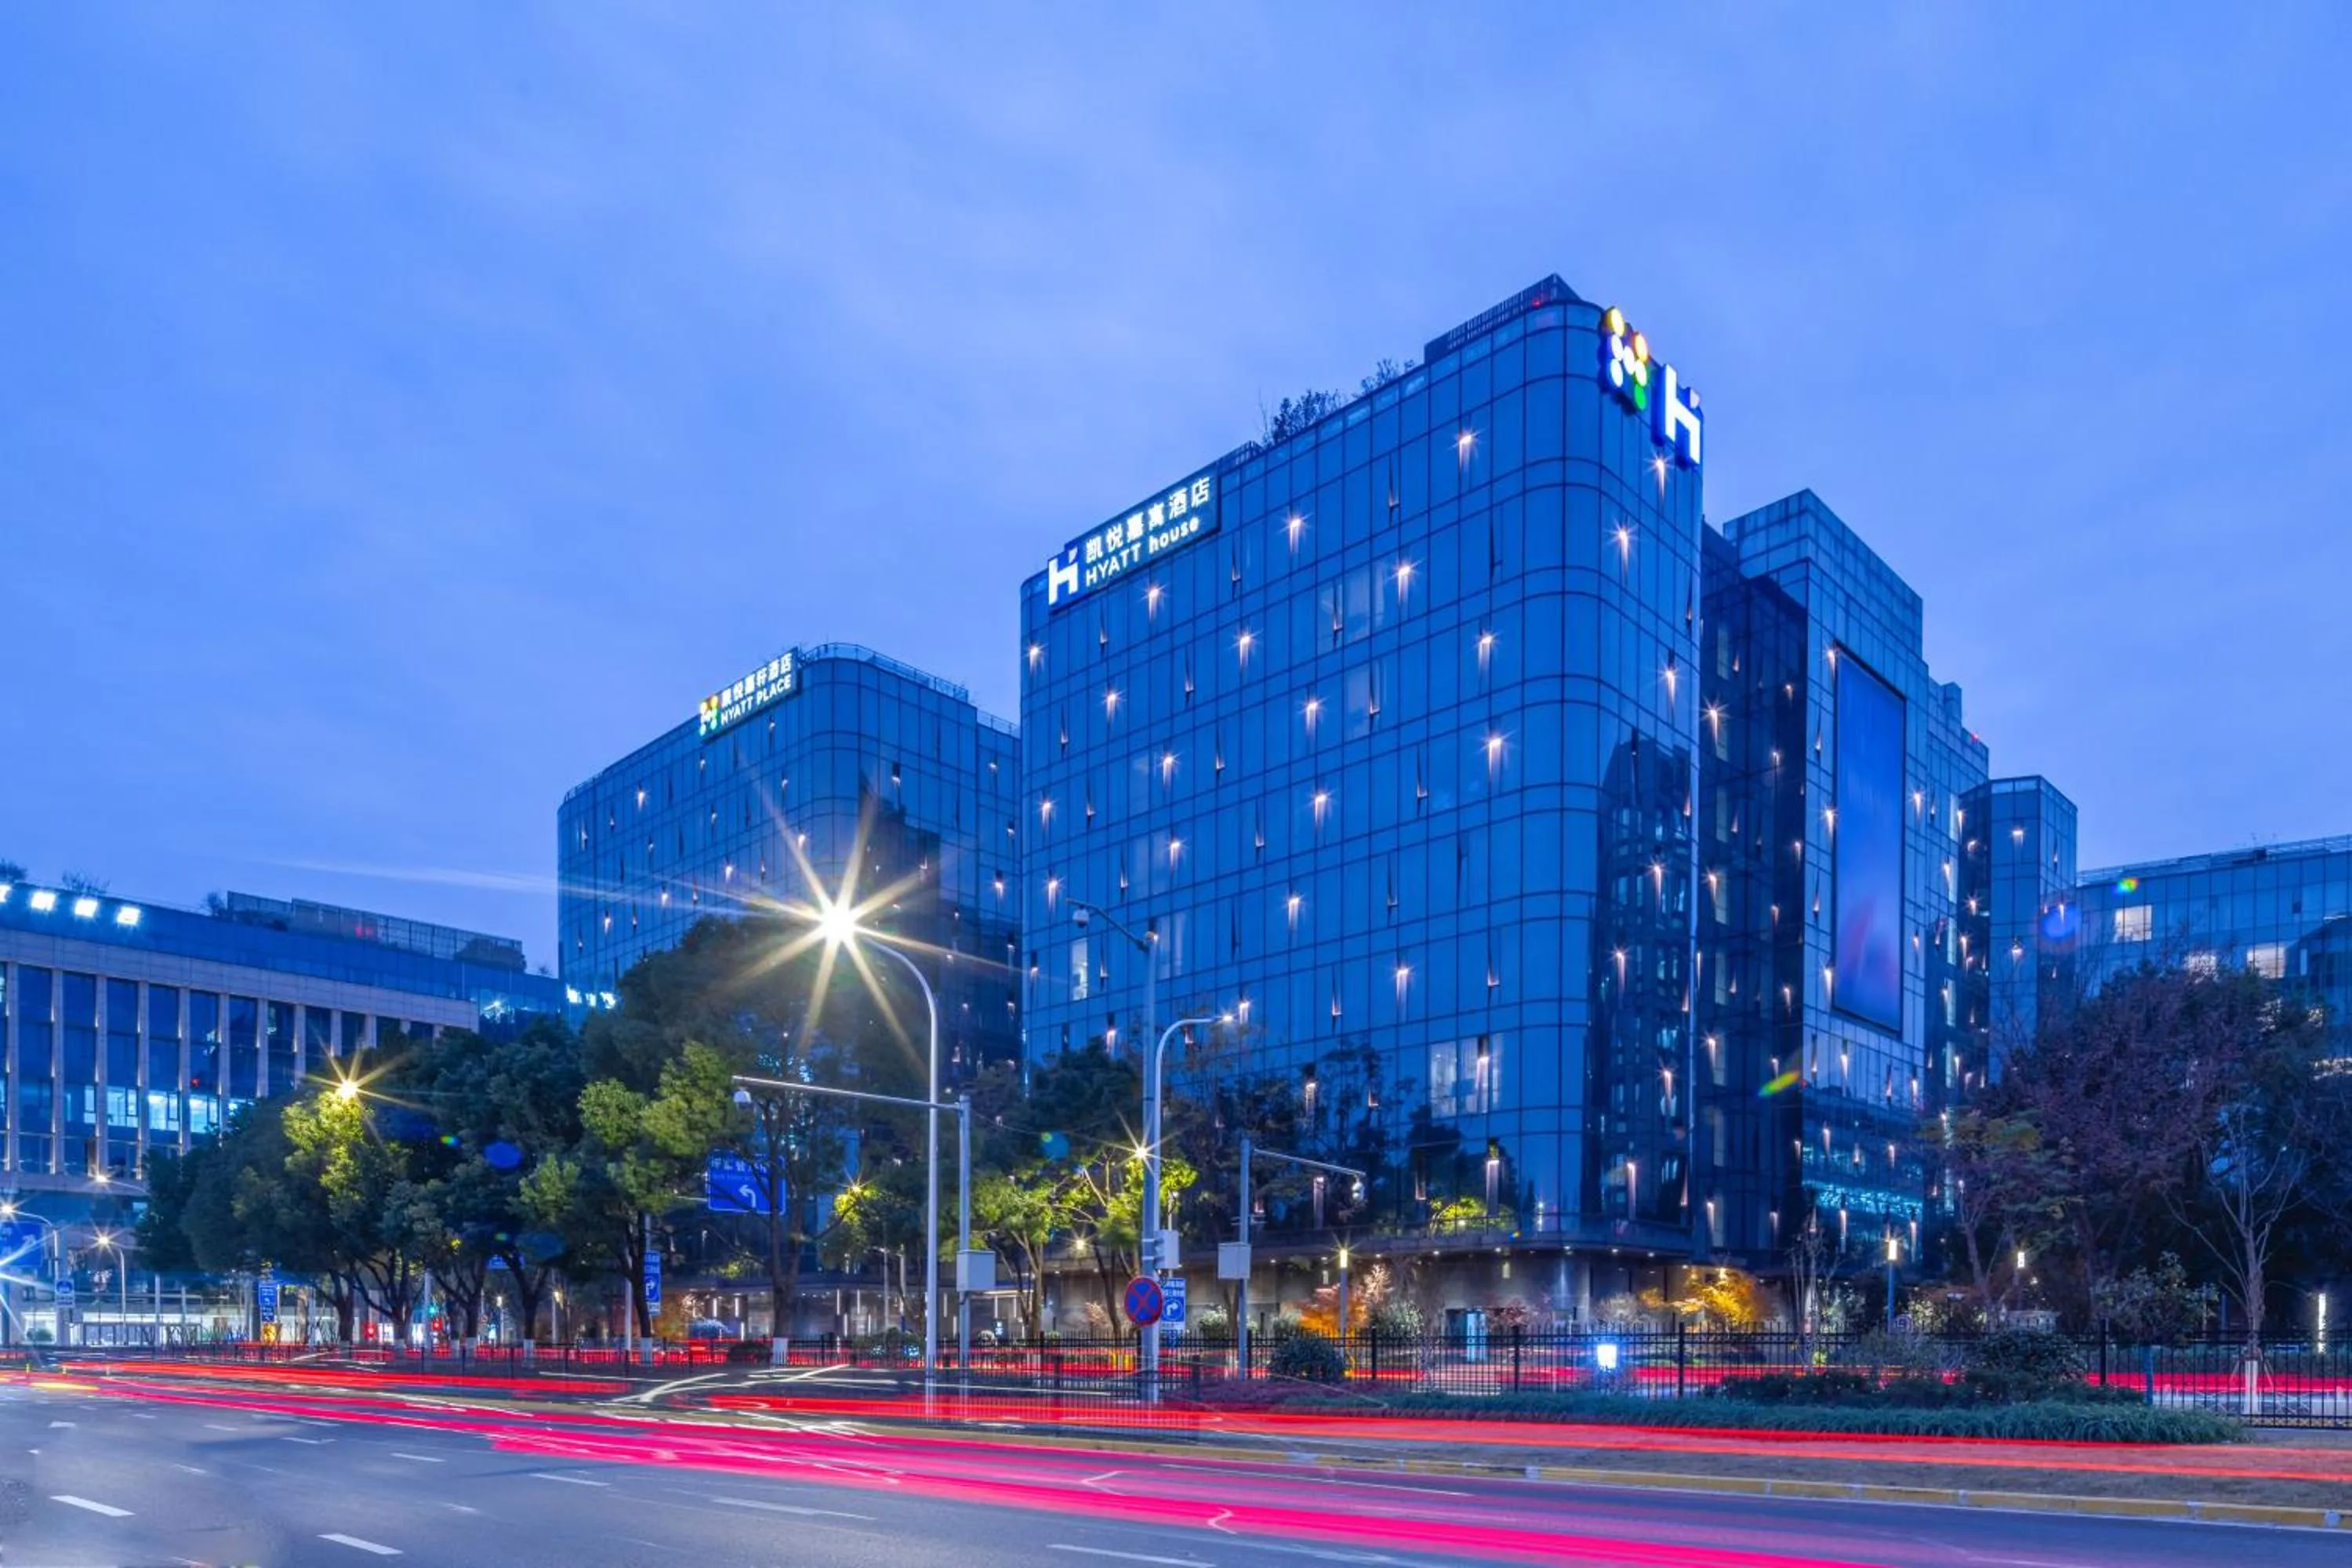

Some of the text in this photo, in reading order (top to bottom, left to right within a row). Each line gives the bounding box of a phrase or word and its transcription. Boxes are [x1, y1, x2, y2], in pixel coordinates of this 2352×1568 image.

[1086, 517, 1200, 587] HYATT house
[720, 674, 791, 725] HYATT PLACE
